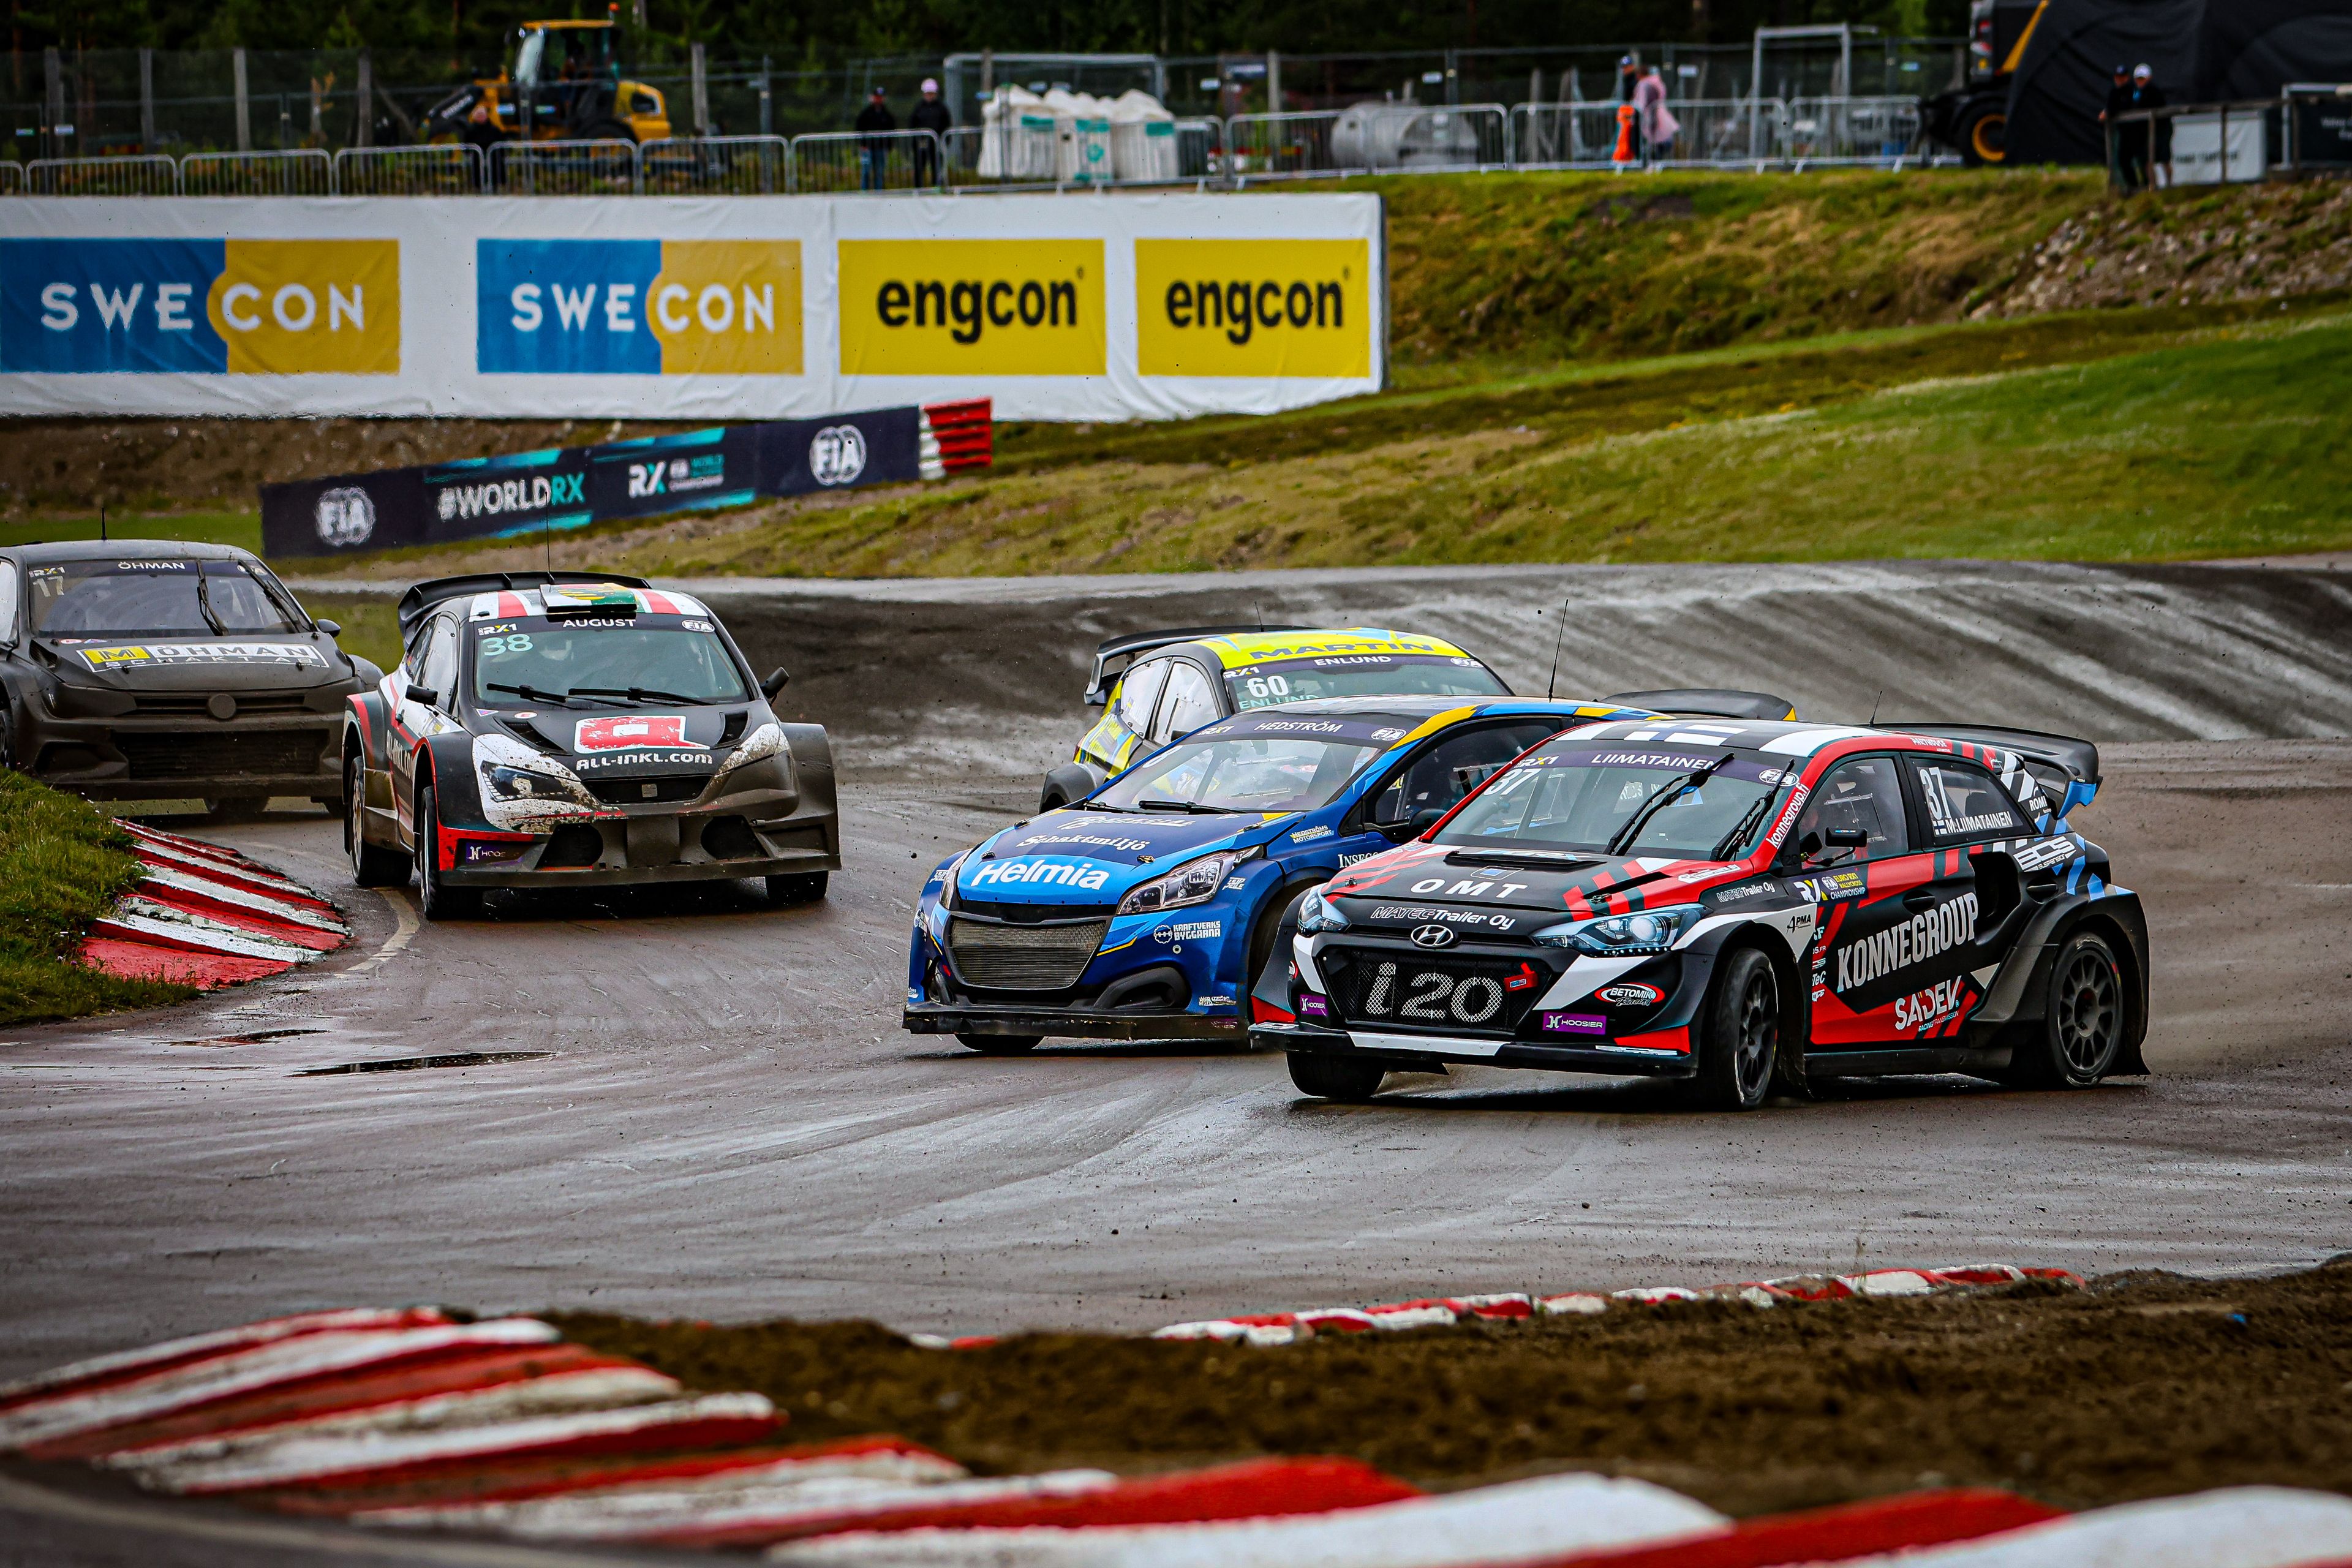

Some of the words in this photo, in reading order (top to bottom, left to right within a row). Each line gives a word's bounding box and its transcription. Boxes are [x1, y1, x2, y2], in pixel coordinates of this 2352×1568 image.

[41, 282, 364, 331] SWECON
[511, 284, 774, 333] SWECON
[878, 279, 1076, 344] engcon
[1167, 281, 1343, 344] engcon
[437, 472, 585, 521] #WORLDRX
[562, 619, 636, 628] AUGUST
[157, 646, 309, 656] ÖHMAN
[483, 633, 533, 657] 38
[1250, 643, 1436, 659] MARTIN
[1314, 655, 1392, 666] ENLUND
[1245, 675, 1289, 698] 60
[1254, 721, 1344, 733] HEDSTRÖM
[1591, 754, 1722, 771] LIIMATAINEN
[1484, 768, 1543, 796] 37
[1920, 767, 1951, 820] 37
[2029, 796, 2048, 811] ROMI
[1766, 783, 1810, 848] konnegroup.fi
[1945, 811, 2013, 833] M.LIIMATAINEN
[1292, 825, 1329, 837] HEDSTRÖMS
[1293, 830, 1332, 844] MOTORSPORT
[970, 859, 1110, 890] Helmia
[1763, 882, 1776, 892] Oy
[1830, 887, 1866, 899] CHAMPIONSHIP
[1489, 914, 1516, 930] Oy
[1838, 892, 1978, 993] KONNEGROUP
[1366, 962, 1502, 1023] i20
[1610, 987, 1654, 1000] BETOMIK
[1895, 975, 1962, 1030] SADEV
[1561, 1019, 1603, 1028] HOOSIER
